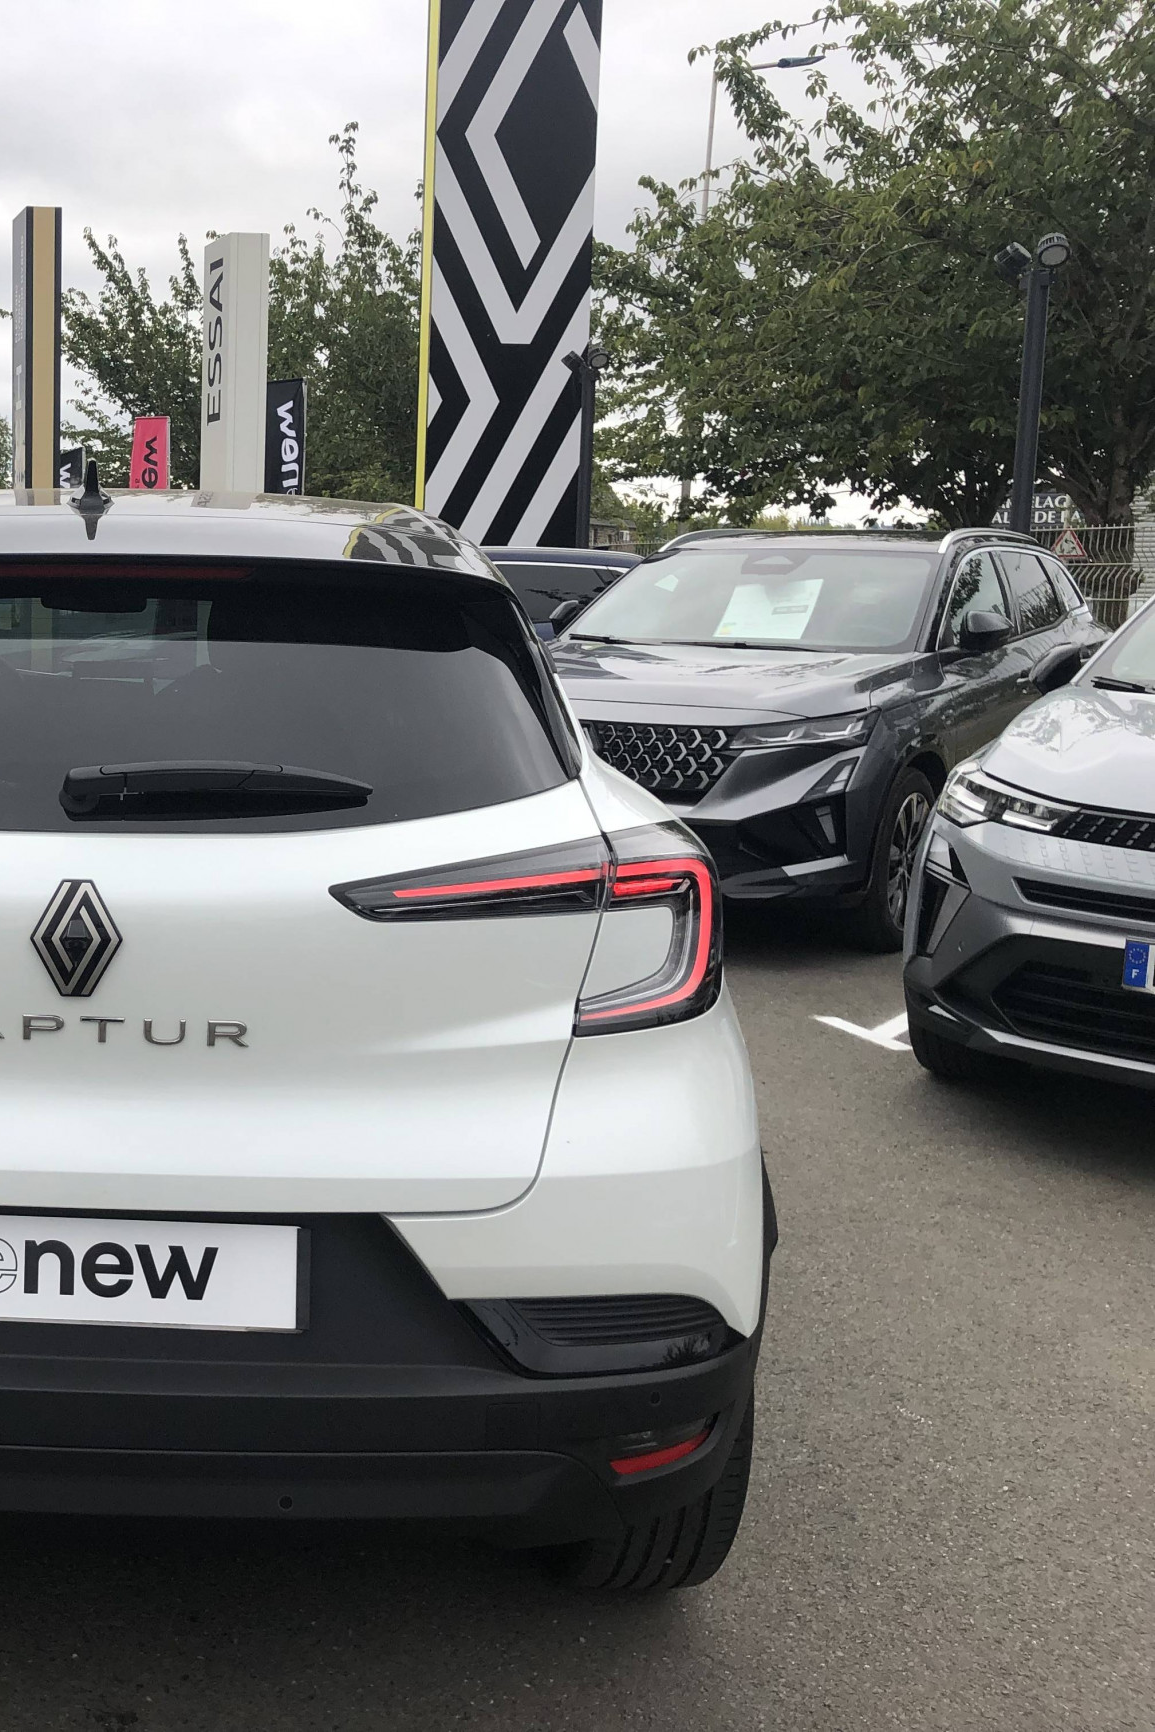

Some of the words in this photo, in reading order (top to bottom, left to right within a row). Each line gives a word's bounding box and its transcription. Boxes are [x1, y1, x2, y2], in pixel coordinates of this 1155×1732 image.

[207, 257, 224, 426] ESSAI
[1033, 510, 1057, 524] DE
[1131, 968, 1140, 979] F
